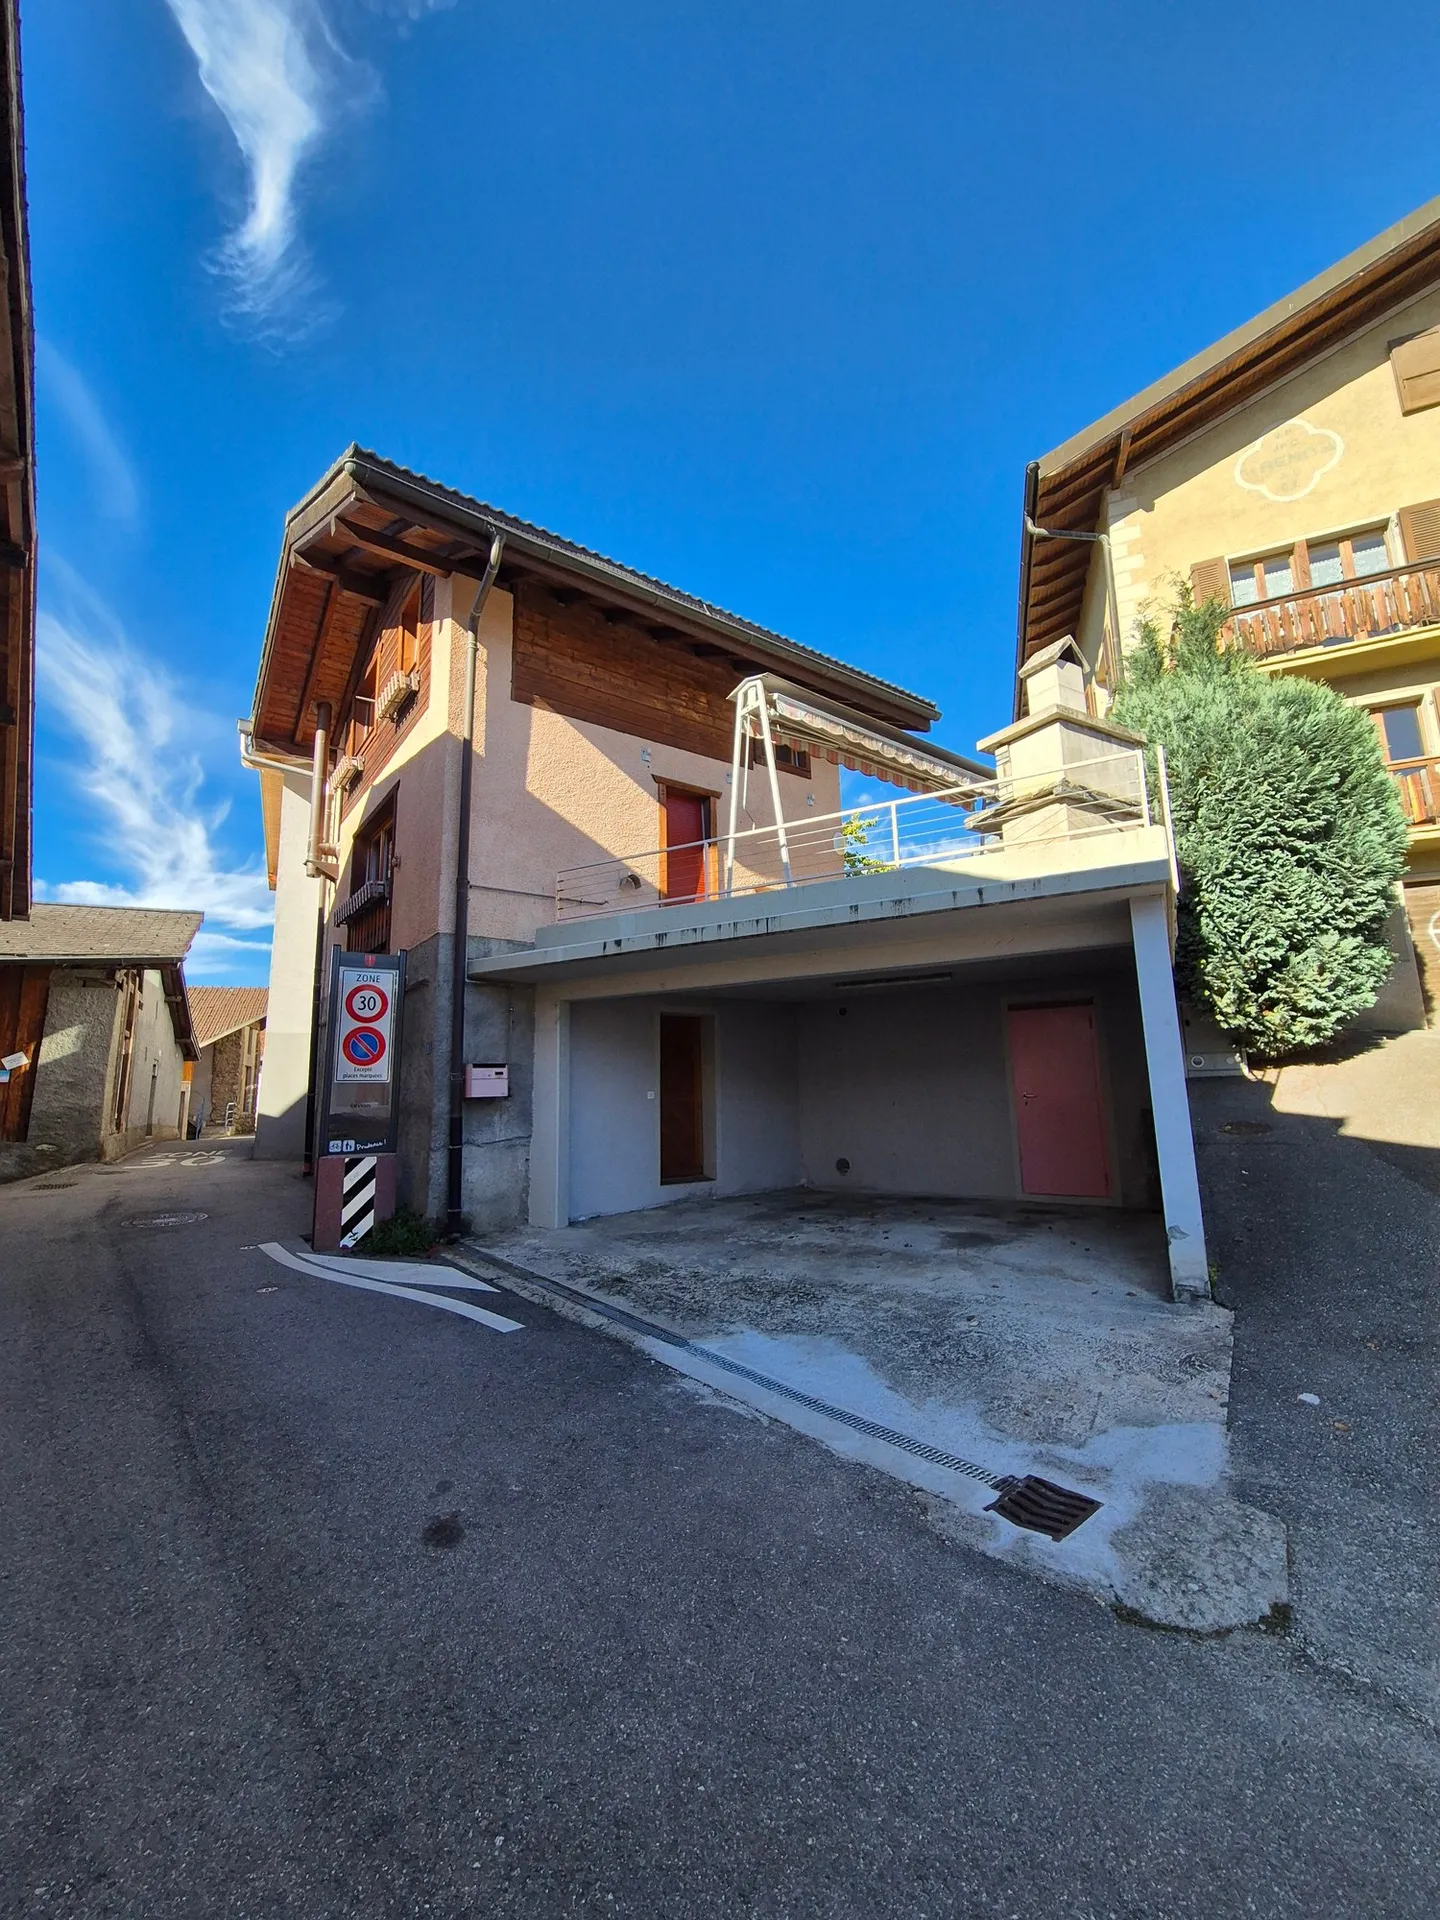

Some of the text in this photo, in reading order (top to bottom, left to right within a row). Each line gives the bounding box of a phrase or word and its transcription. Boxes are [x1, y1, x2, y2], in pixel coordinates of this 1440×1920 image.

[356, 973, 381, 983] ZONE
[357, 995, 376, 1011] 30
[147, 1149, 234, 1159] ZONE
[121, 1155, 226, 1169] 30
